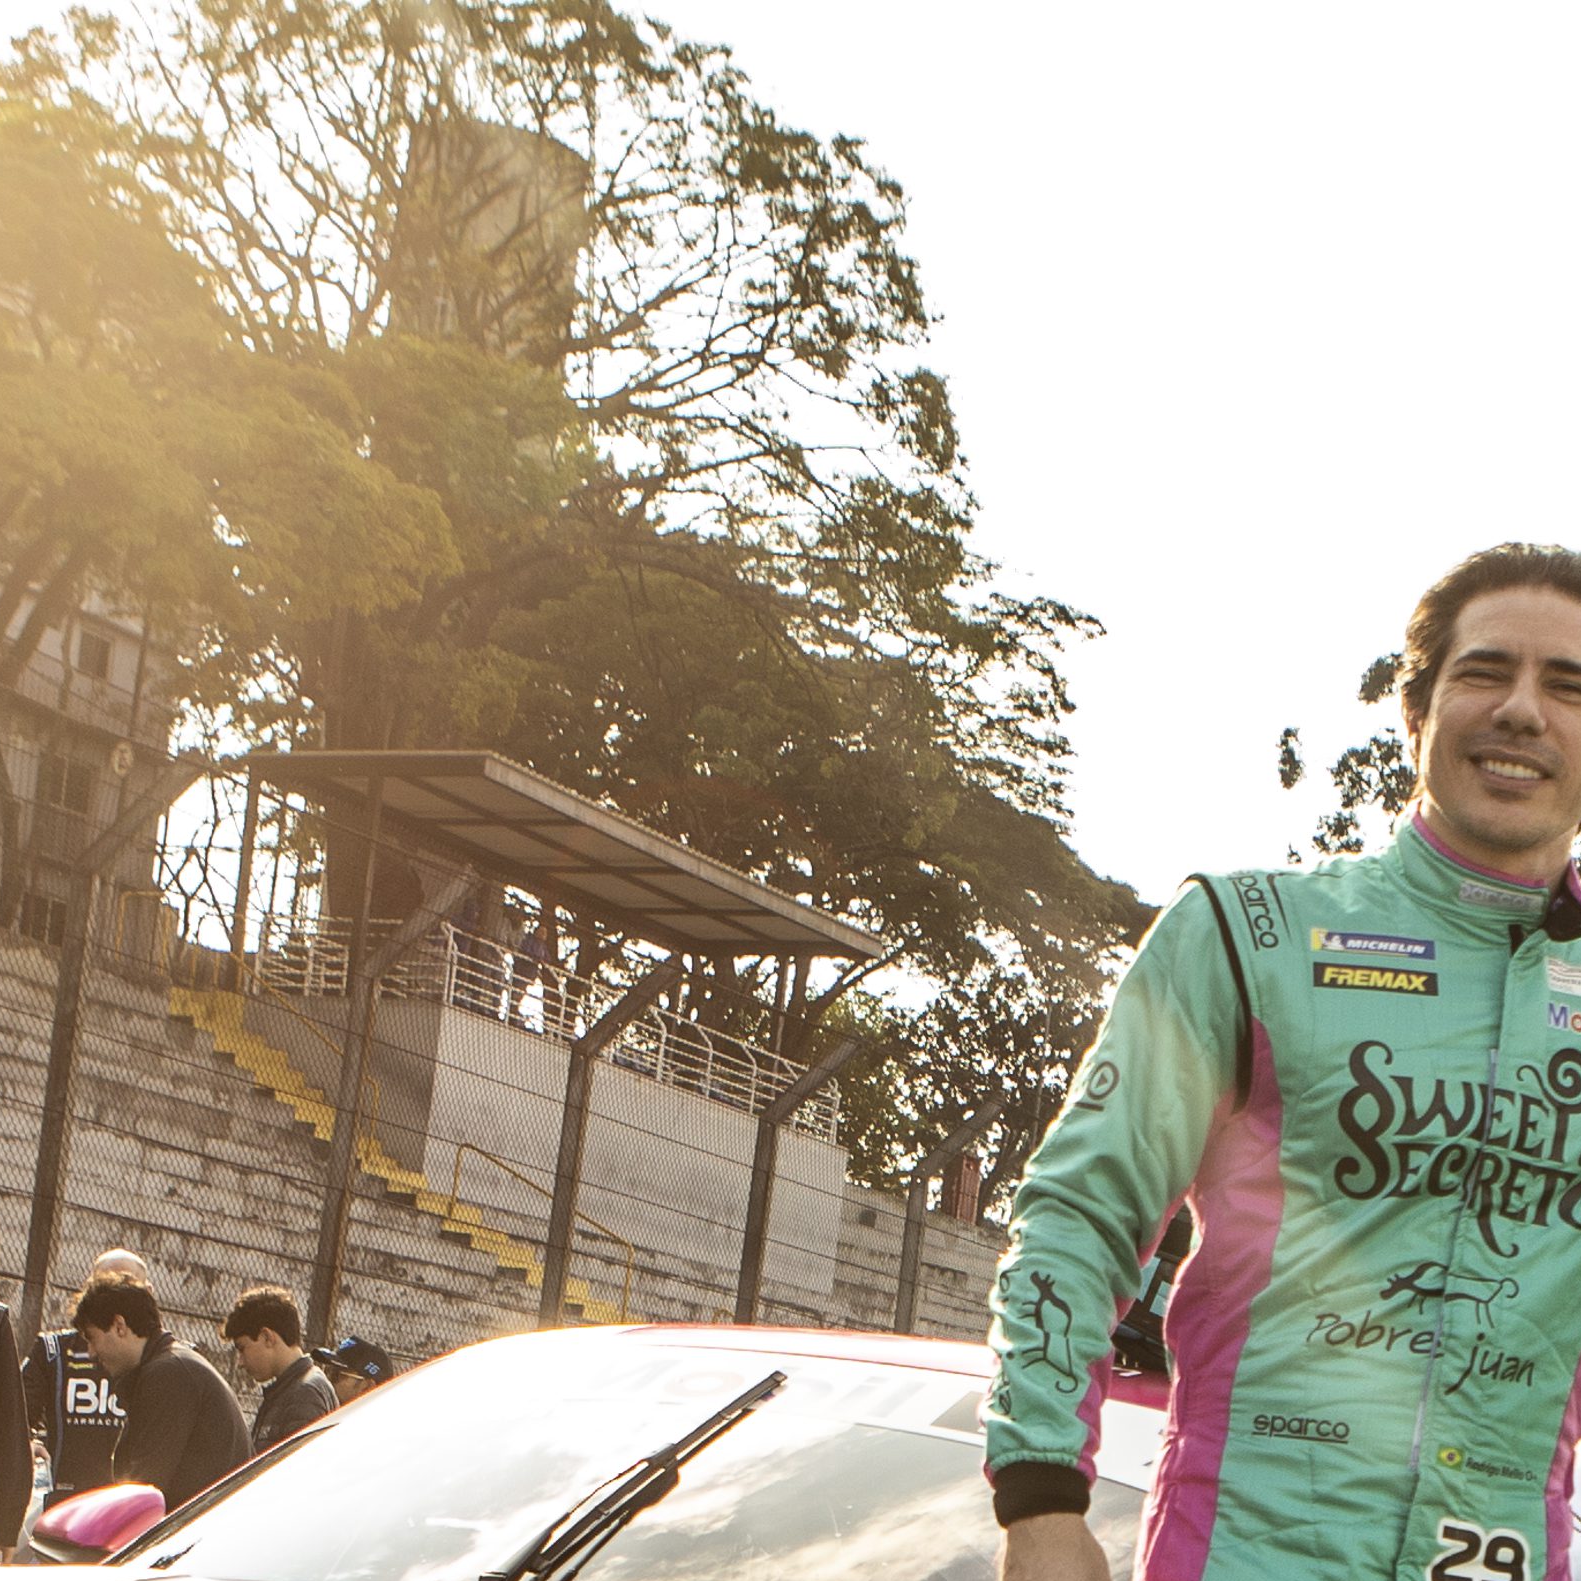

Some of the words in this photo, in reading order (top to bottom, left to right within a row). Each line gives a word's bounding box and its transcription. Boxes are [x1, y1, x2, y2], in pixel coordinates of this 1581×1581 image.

[1233, 870, 1280, 950] parco
[1347, 939, 1426, 954] MICHELIN
[1323, 967, 1428, 992] FREMAX
[1306, 1310, 1444, 1359] Pobre
[1252, 1413, 1351, 1444] sparco
